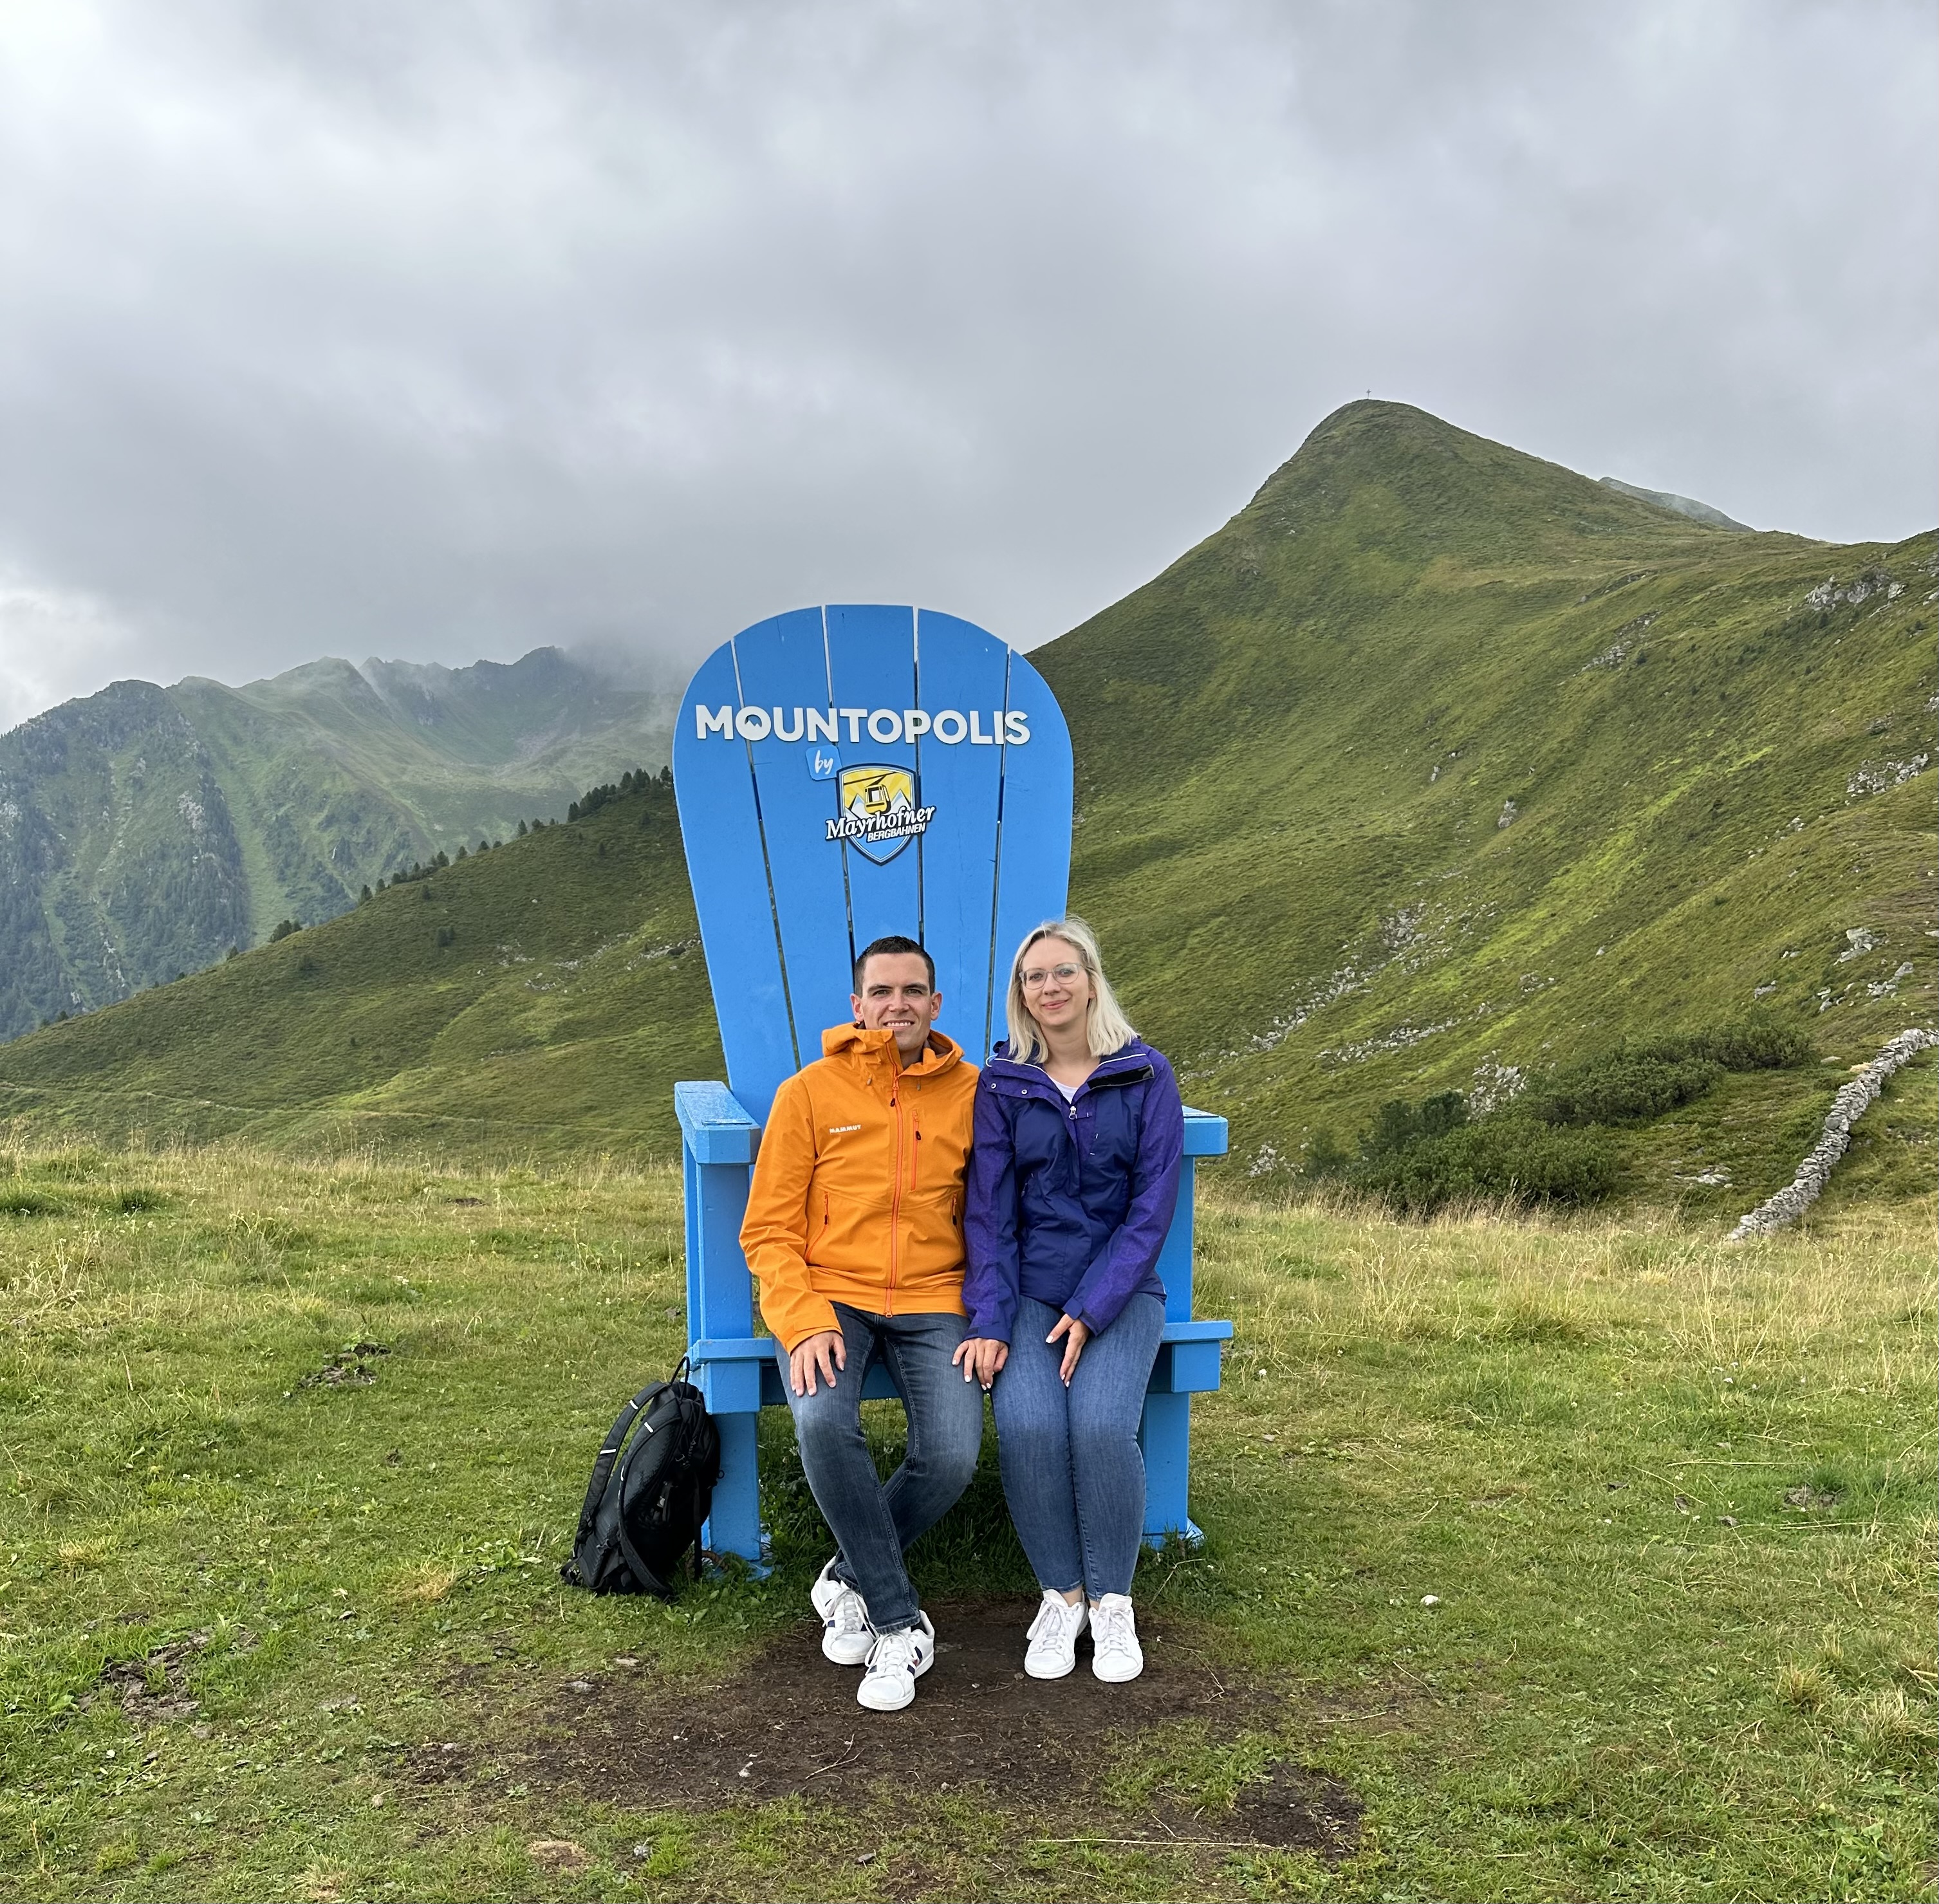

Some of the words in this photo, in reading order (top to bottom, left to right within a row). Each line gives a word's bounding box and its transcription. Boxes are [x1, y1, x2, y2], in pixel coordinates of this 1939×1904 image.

[695, 705, 1030, 745] MOUNTOPOLIS
[815, 750, 834, 775] by
[826, 806, 936, 840] Mayrhofner
[867, 822, 926, 842] BERGBAHNEN
[829, 1124, 862, 1134] MAMMUT
